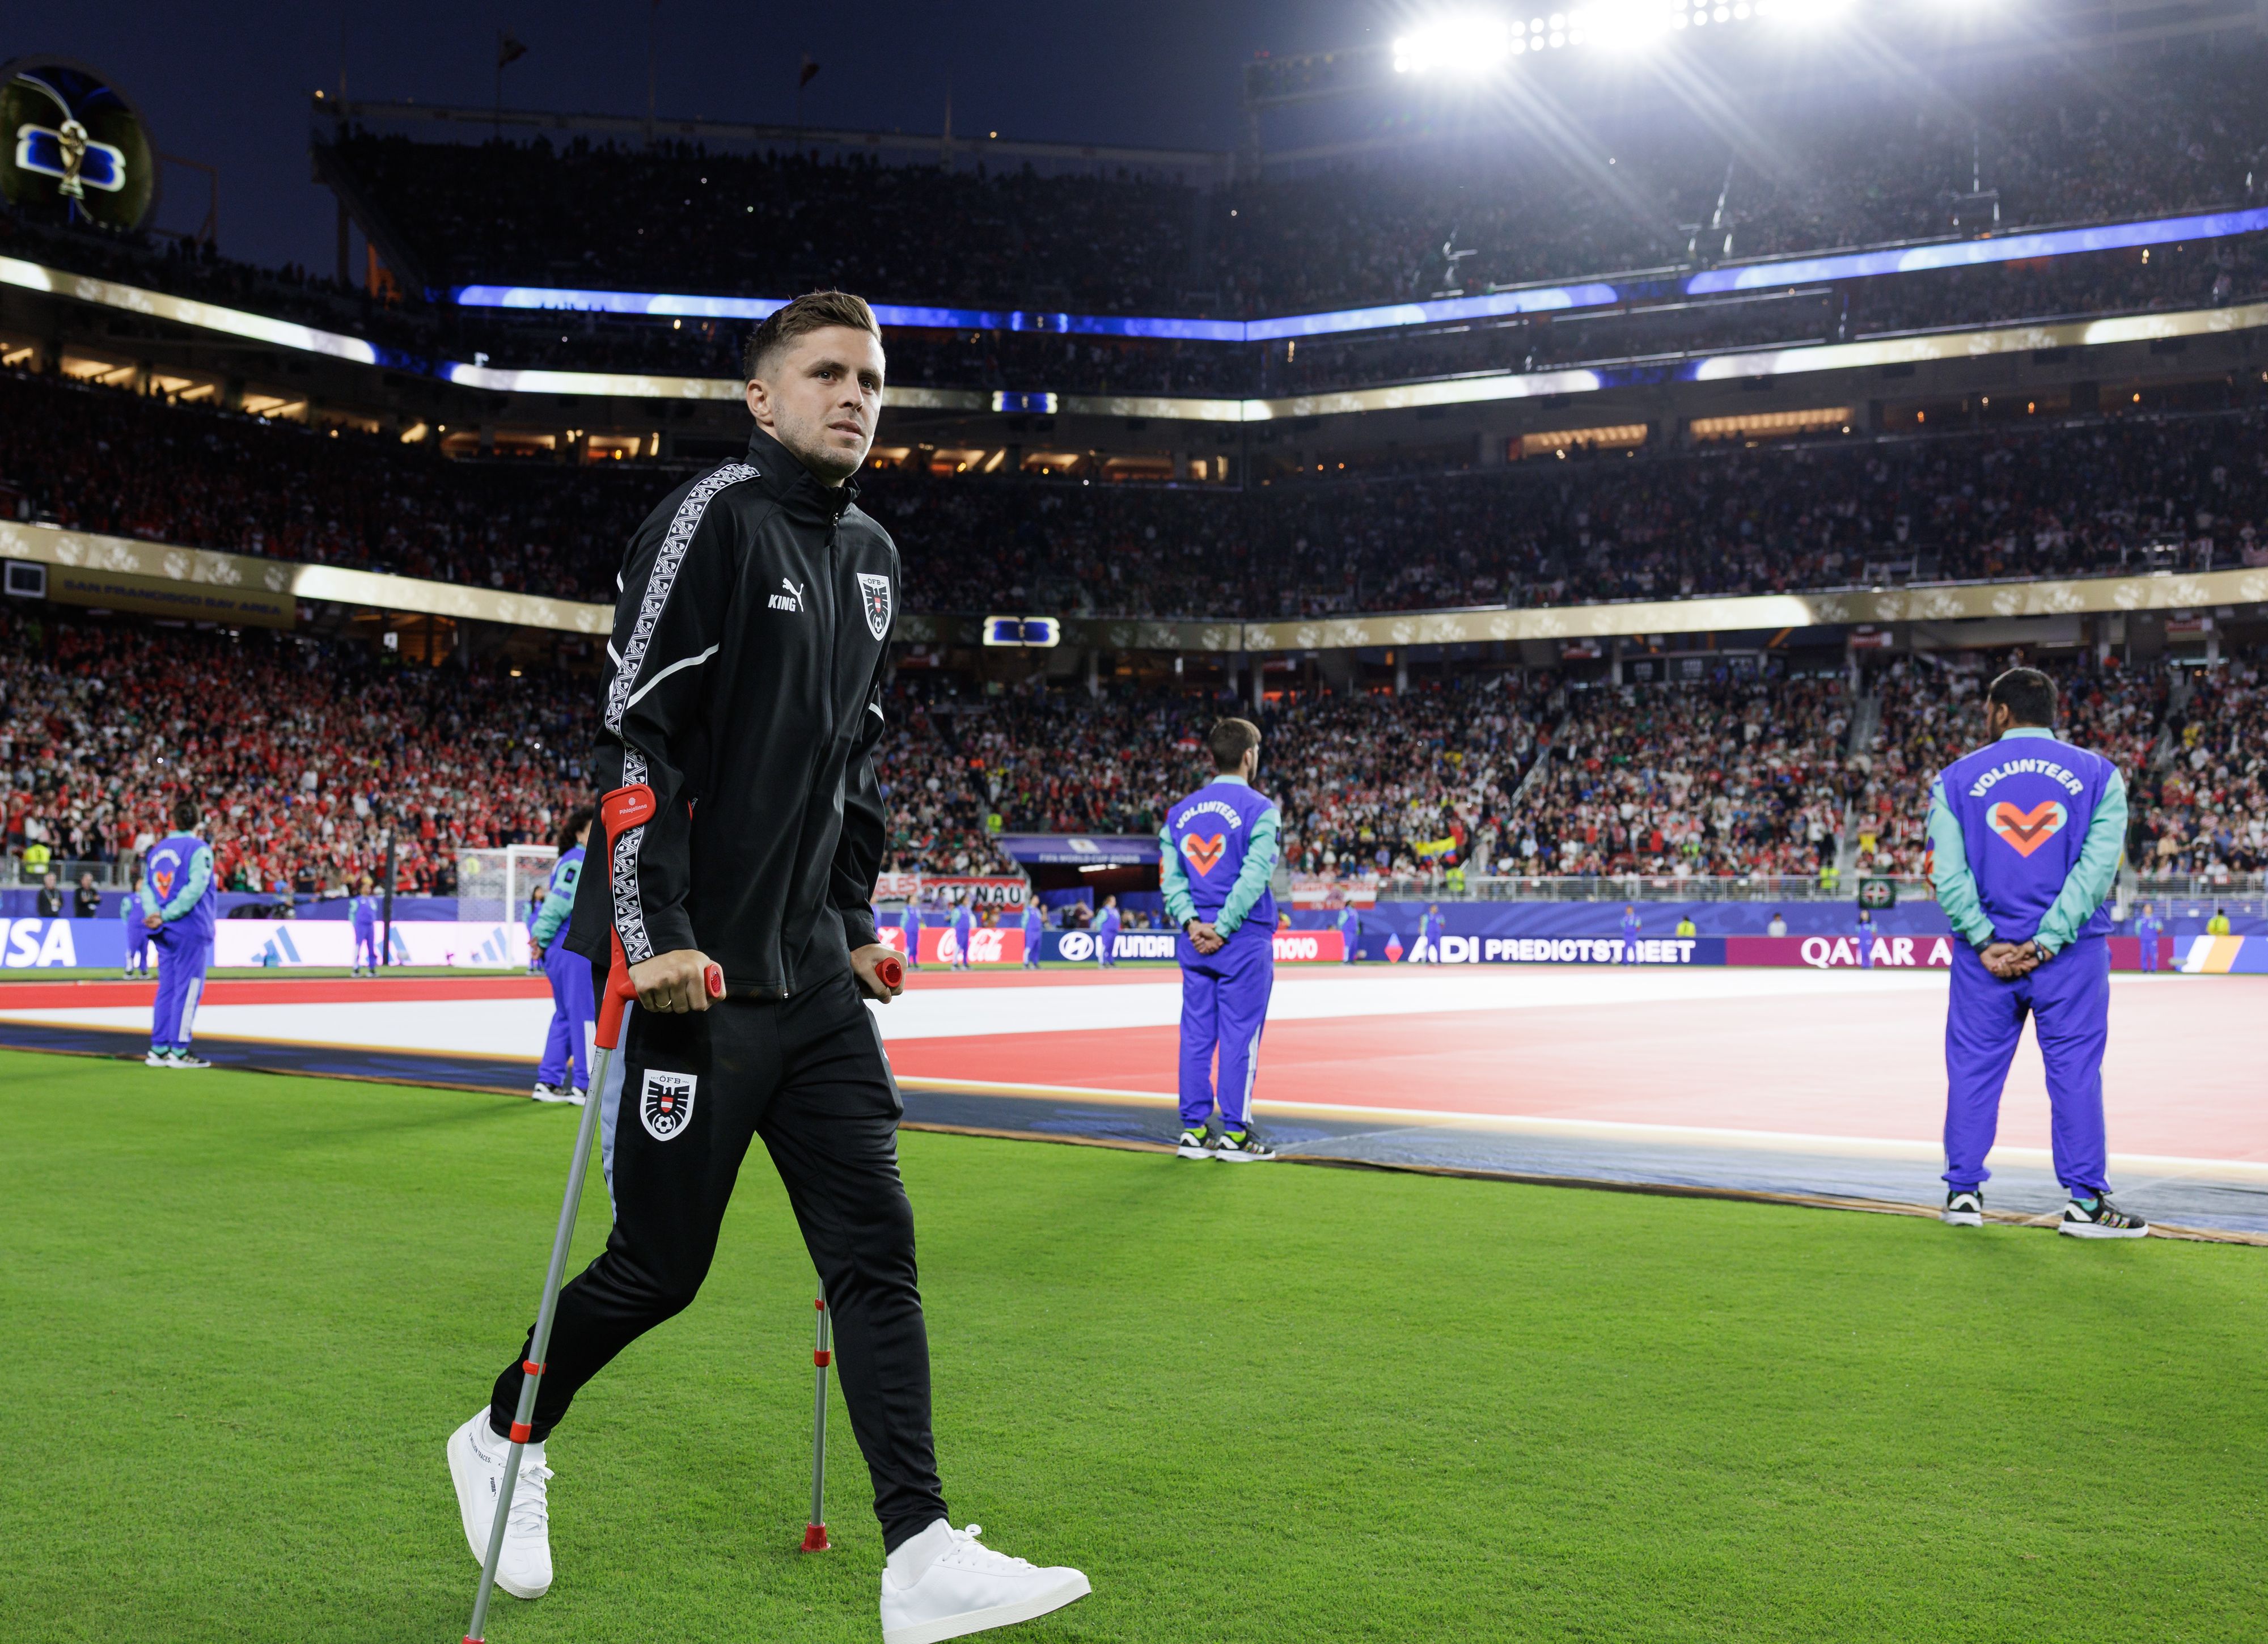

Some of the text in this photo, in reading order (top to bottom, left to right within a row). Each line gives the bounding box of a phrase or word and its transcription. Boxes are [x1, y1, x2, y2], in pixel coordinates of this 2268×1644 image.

[768, 594, 796, 612] KING
[1969, 758, 2084, 797] VOLUNTEER
[619, 804, 648, 815] Pihlajalinna
[1175, 800, 1242, 830] VOLUNTEER
[0, 918, 77, 967] ISA
[1272, 937, 1318, 960] novo
[659, 1075, 681, 1084] ÖFB
[477, 1450, 492, 1464] TRACES.
